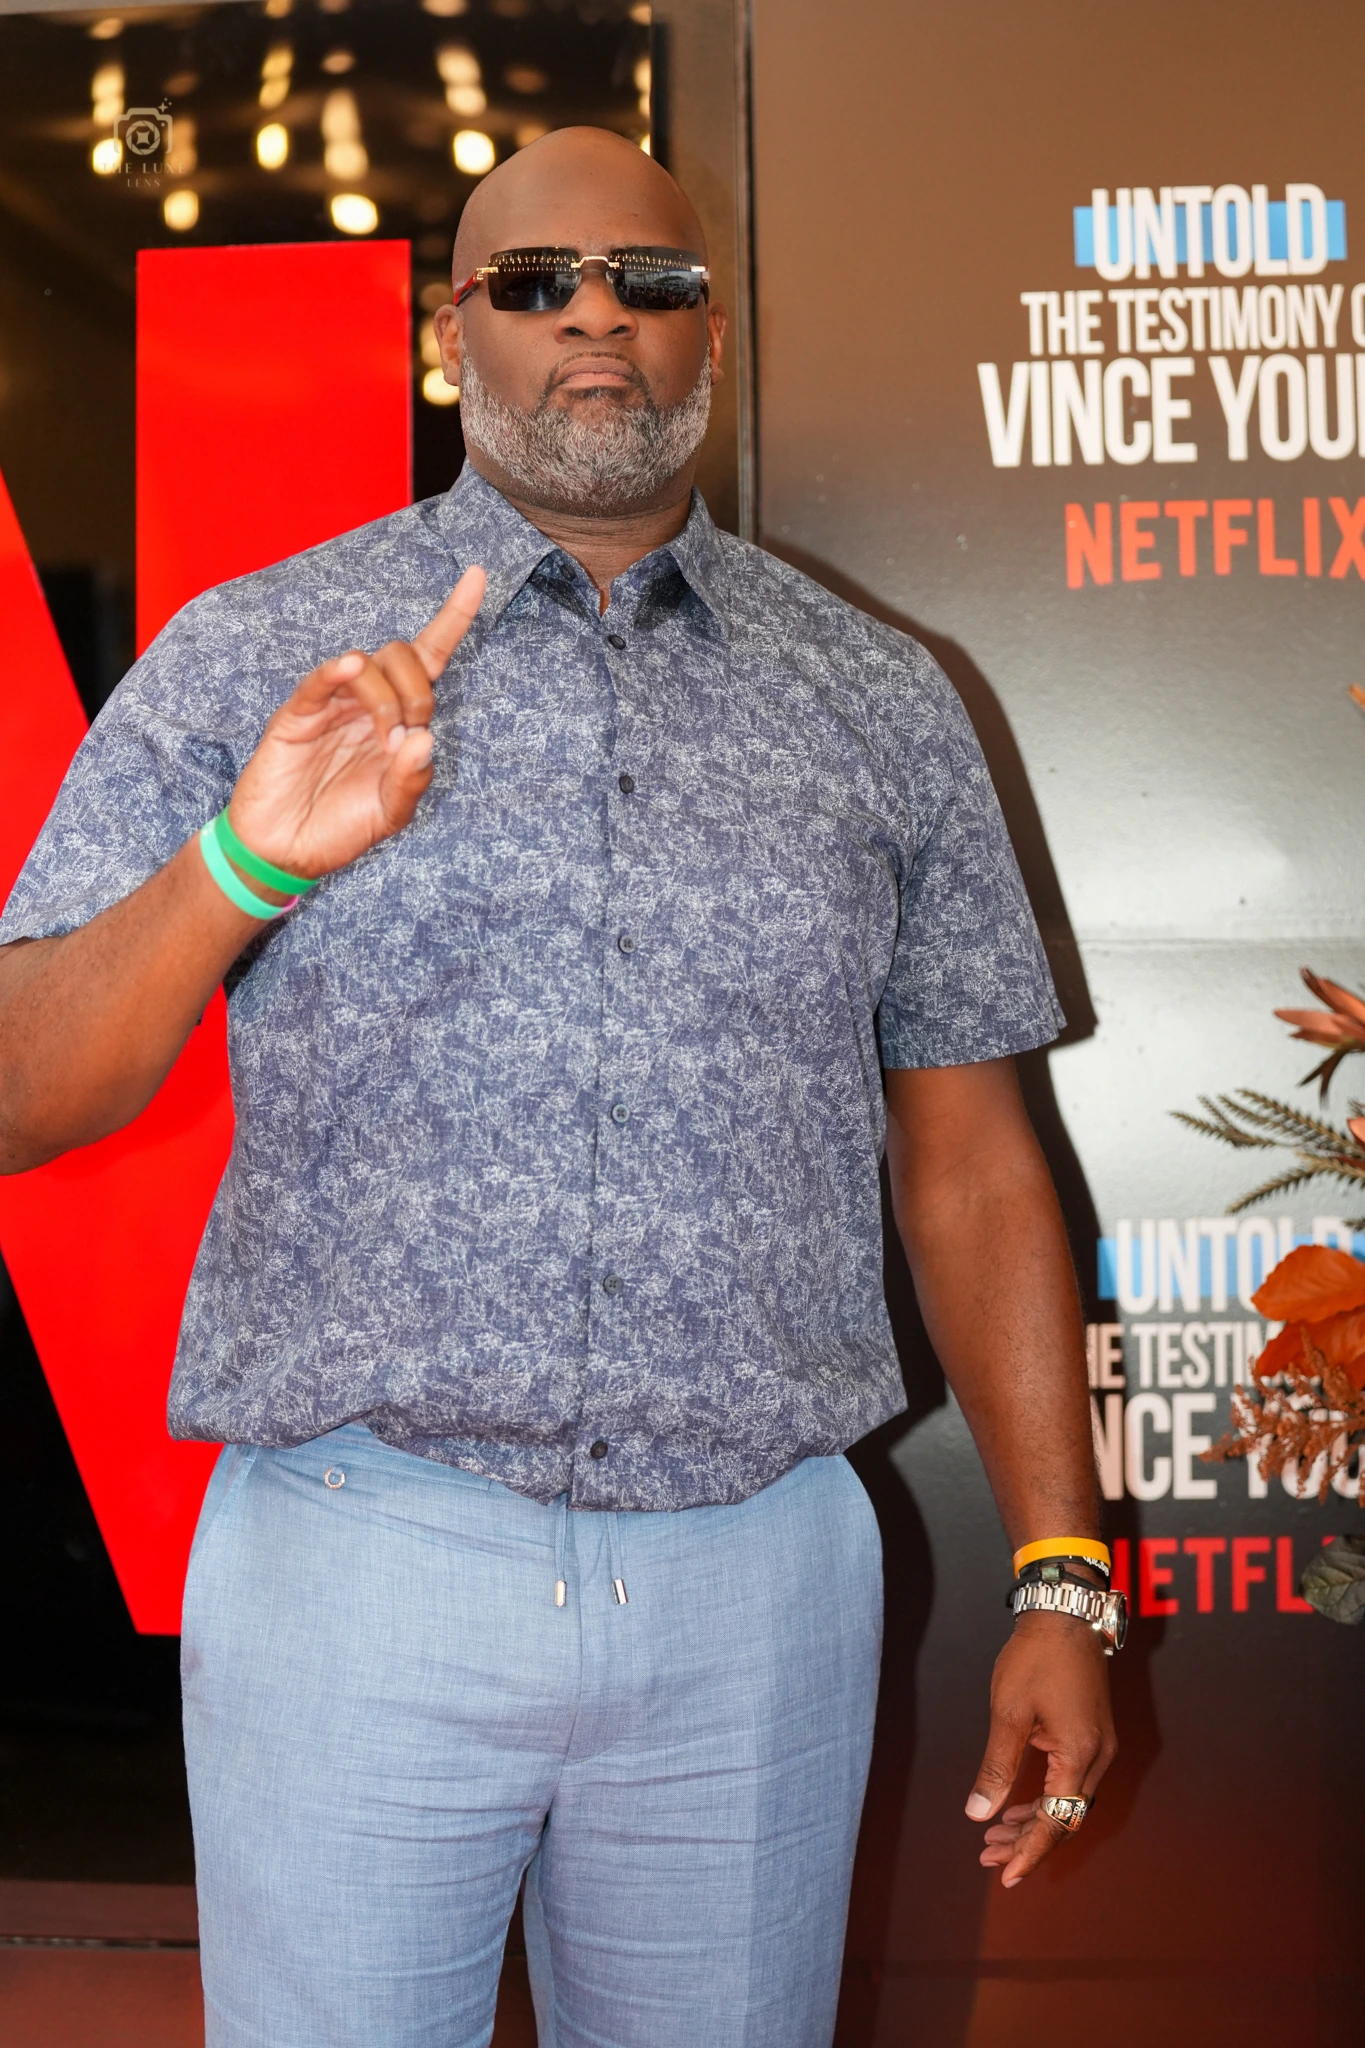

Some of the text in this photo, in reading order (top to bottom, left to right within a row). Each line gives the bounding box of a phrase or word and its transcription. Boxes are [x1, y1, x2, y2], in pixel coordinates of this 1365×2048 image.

[1092, 183, 1329, 281] UNTOLD
[1020, 290, 1105, 356] THE
[1108, 284, 1345, 353] TESTIMONY
[977, 352, 1365, 468] VINCE YOU
[1065, 496, 1365, 590] NETFLIX
[1089, 1392, 1218, 1501] NCE
[1112, 1535, 1338, 1618] ETFL
